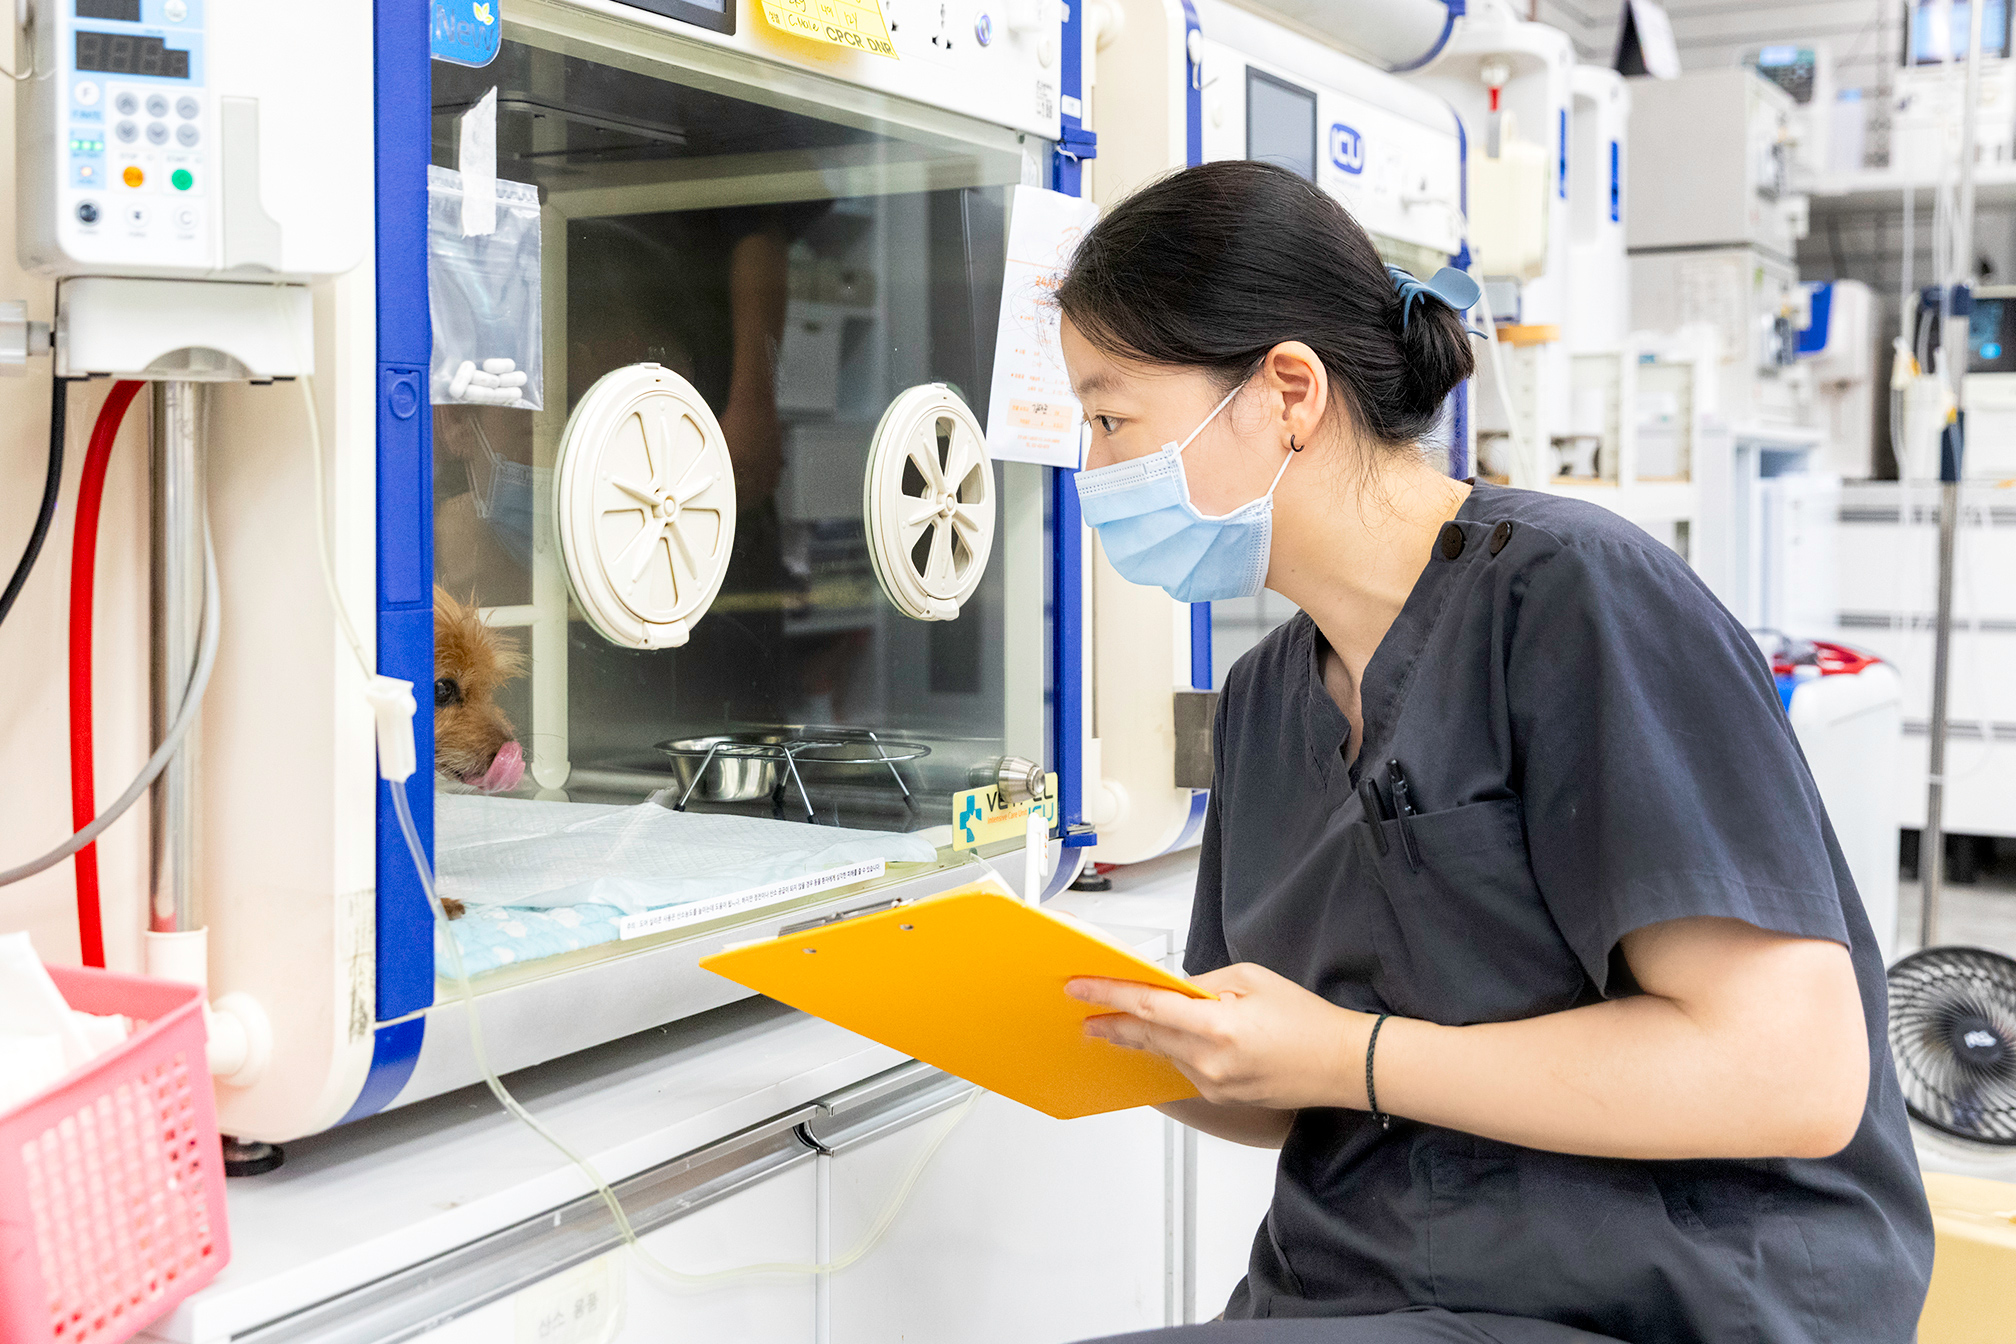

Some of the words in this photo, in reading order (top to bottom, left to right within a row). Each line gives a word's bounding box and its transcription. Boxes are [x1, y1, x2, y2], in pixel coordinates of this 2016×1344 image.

[436, 4, 494, 51] New
[826, 26, 865, 49] CPCR
[866, 37, 895, 56] DNR
[1330, 124, 1363, 173] ICU
[1008, 810, 1018, 820] Care
